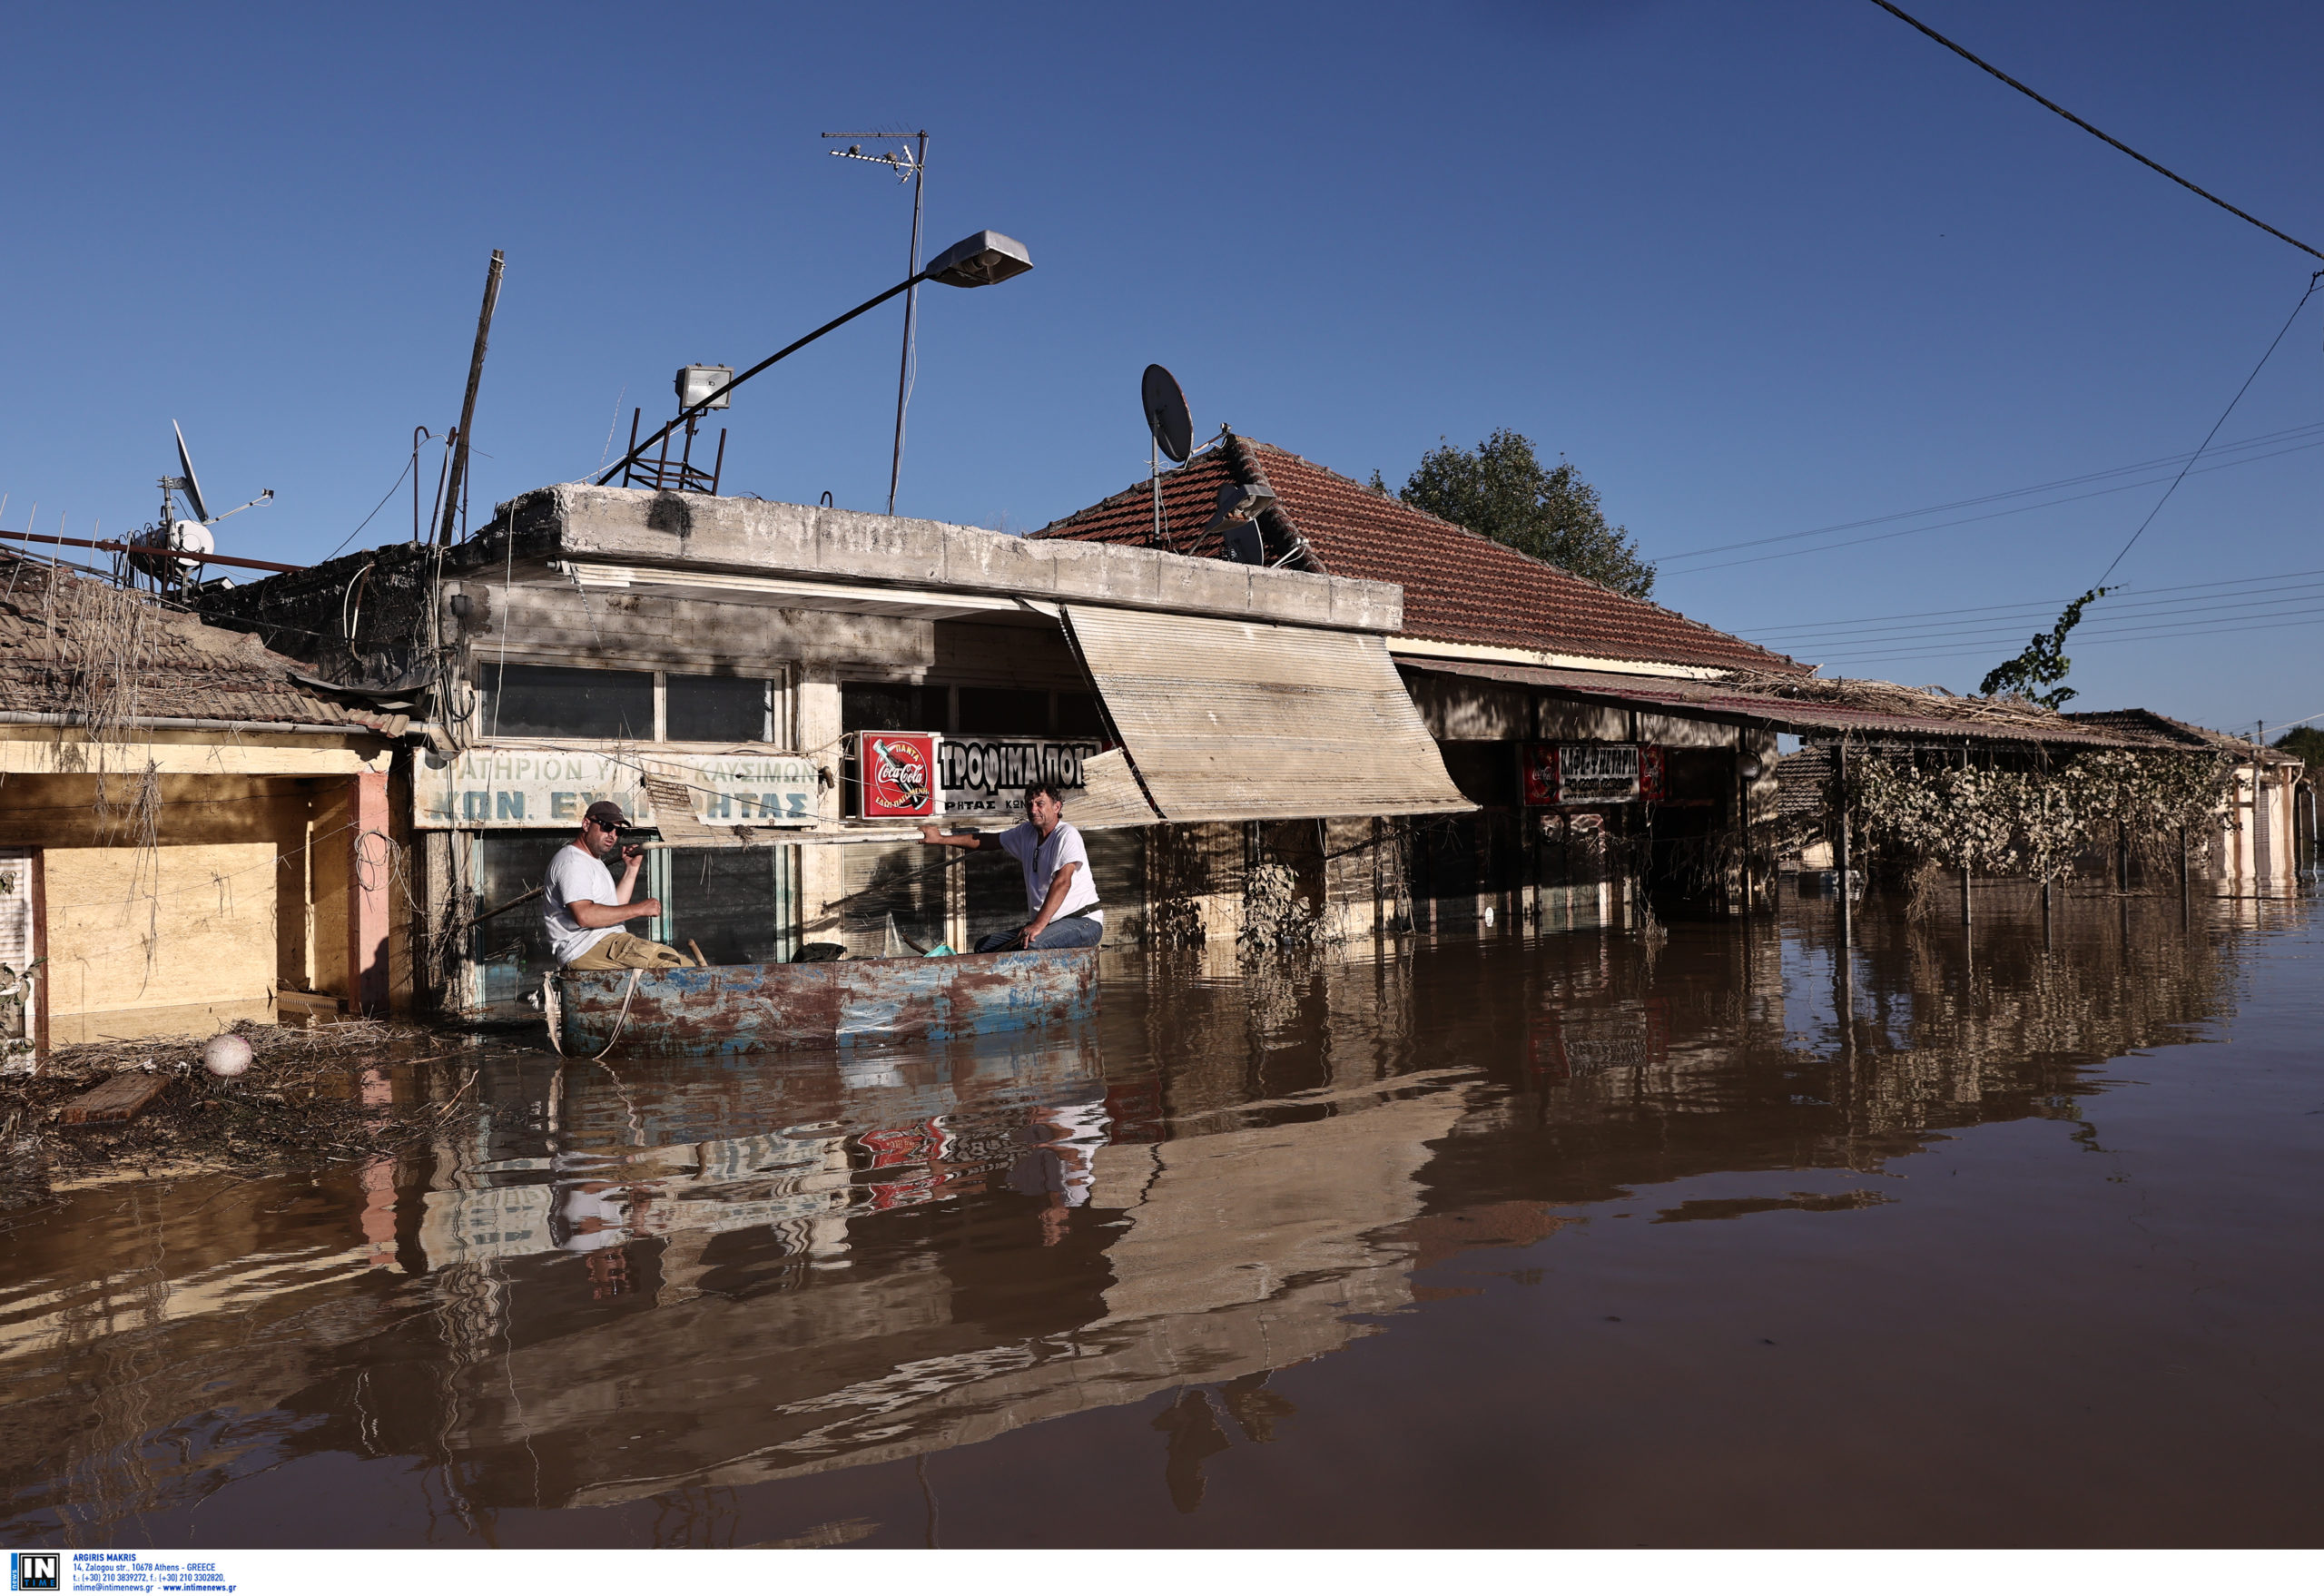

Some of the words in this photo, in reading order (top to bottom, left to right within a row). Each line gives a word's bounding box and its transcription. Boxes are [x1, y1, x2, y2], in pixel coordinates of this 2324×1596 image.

[895, 744, 920, 762] ΠΑΝΤΑ
[427, 756, 583, 781] ΑΤΗΡΙΟΝ
[694, 762, 815, 783] ΚΑΥΣΙΜΩΝ
[878, 764, 924, 783] Coca-Cola
[939, 742, 1039, 794] ΤΡΟΦΙΜΑ
[430, 791, 535, 821] ΚΩΝ.
[945, 801, 996, 811] ΡΗΤΑΣ
